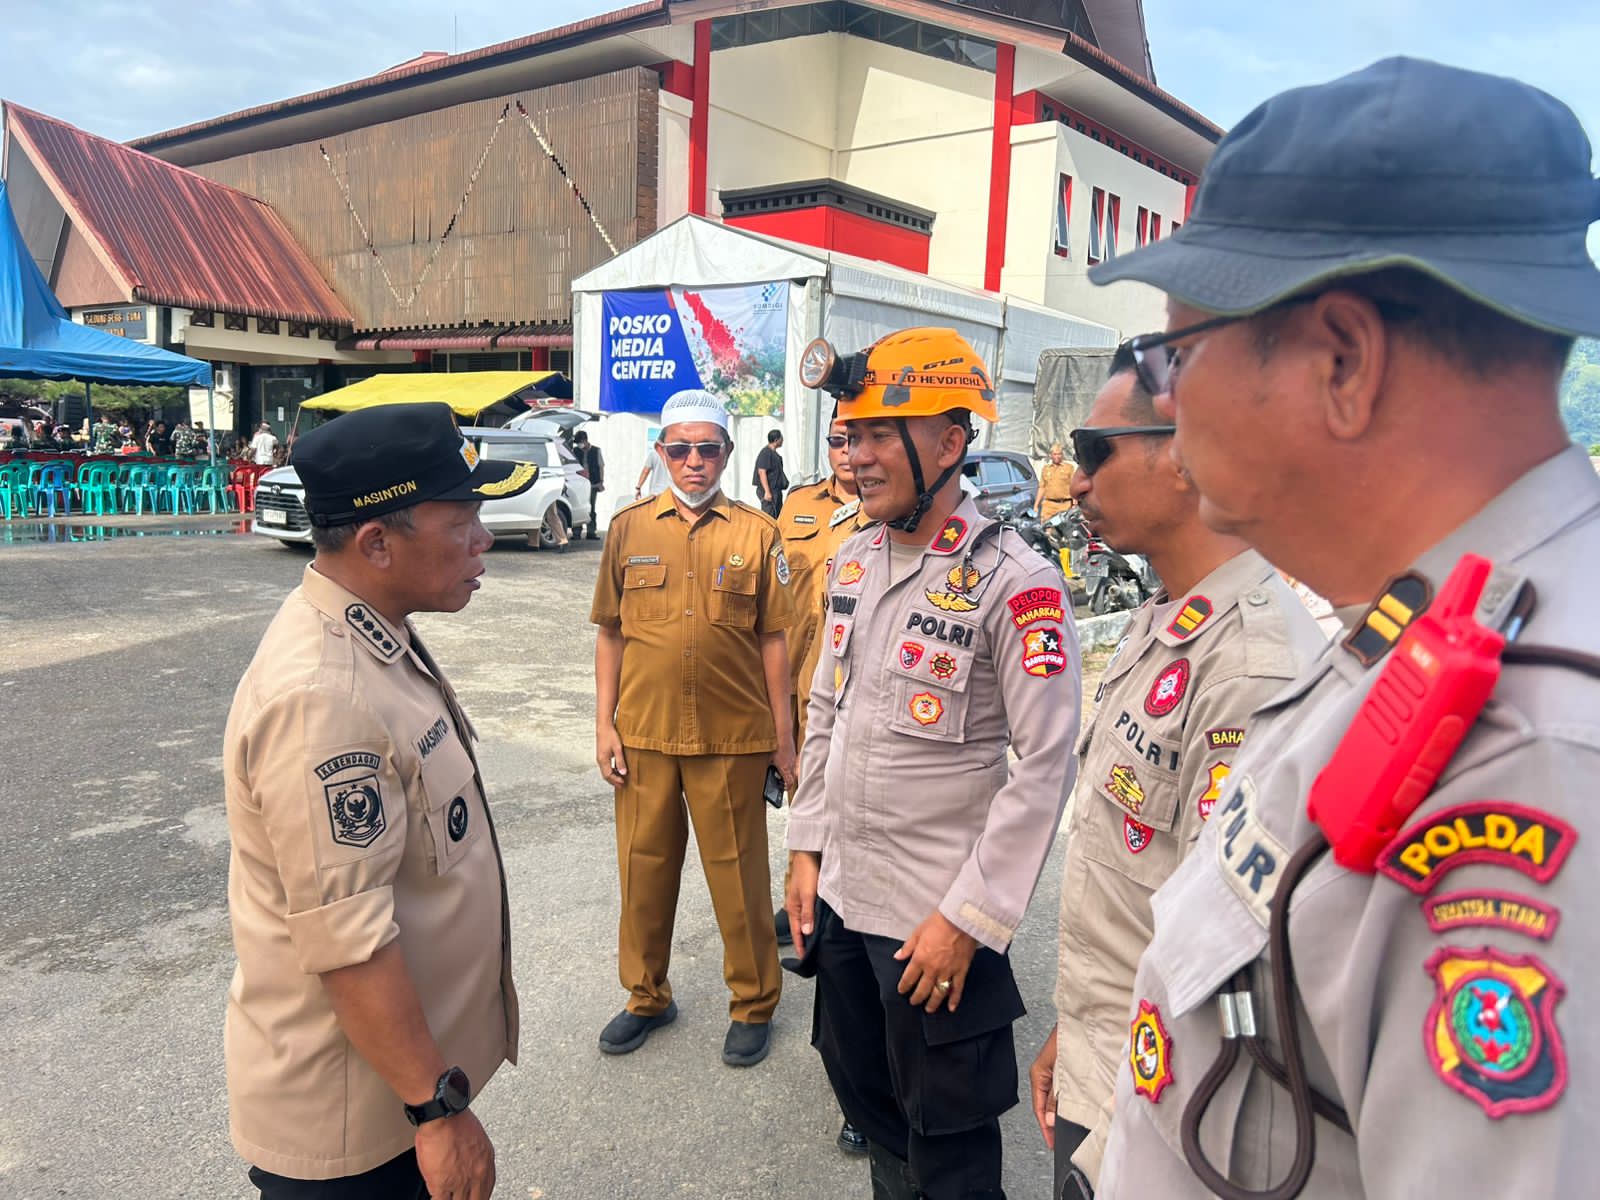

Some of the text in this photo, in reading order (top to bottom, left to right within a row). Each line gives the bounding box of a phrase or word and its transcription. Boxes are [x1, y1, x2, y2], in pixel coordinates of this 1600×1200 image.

[610, 314, 672, 335] POSKO
[611, 337, 664, 358] MEDIA
[612, 360, 676, 380] CENTER
[353, 480, 417, 508] MASINTON
[1012, 590, 1058, 610] PELOPOR
[906, 612, 974, 648] POLRI
[1114, 711, 1180, 772] POLRI
[1221, 786, 1276, 912] POLR
[1400, 814, 1545, 876] POLDA
